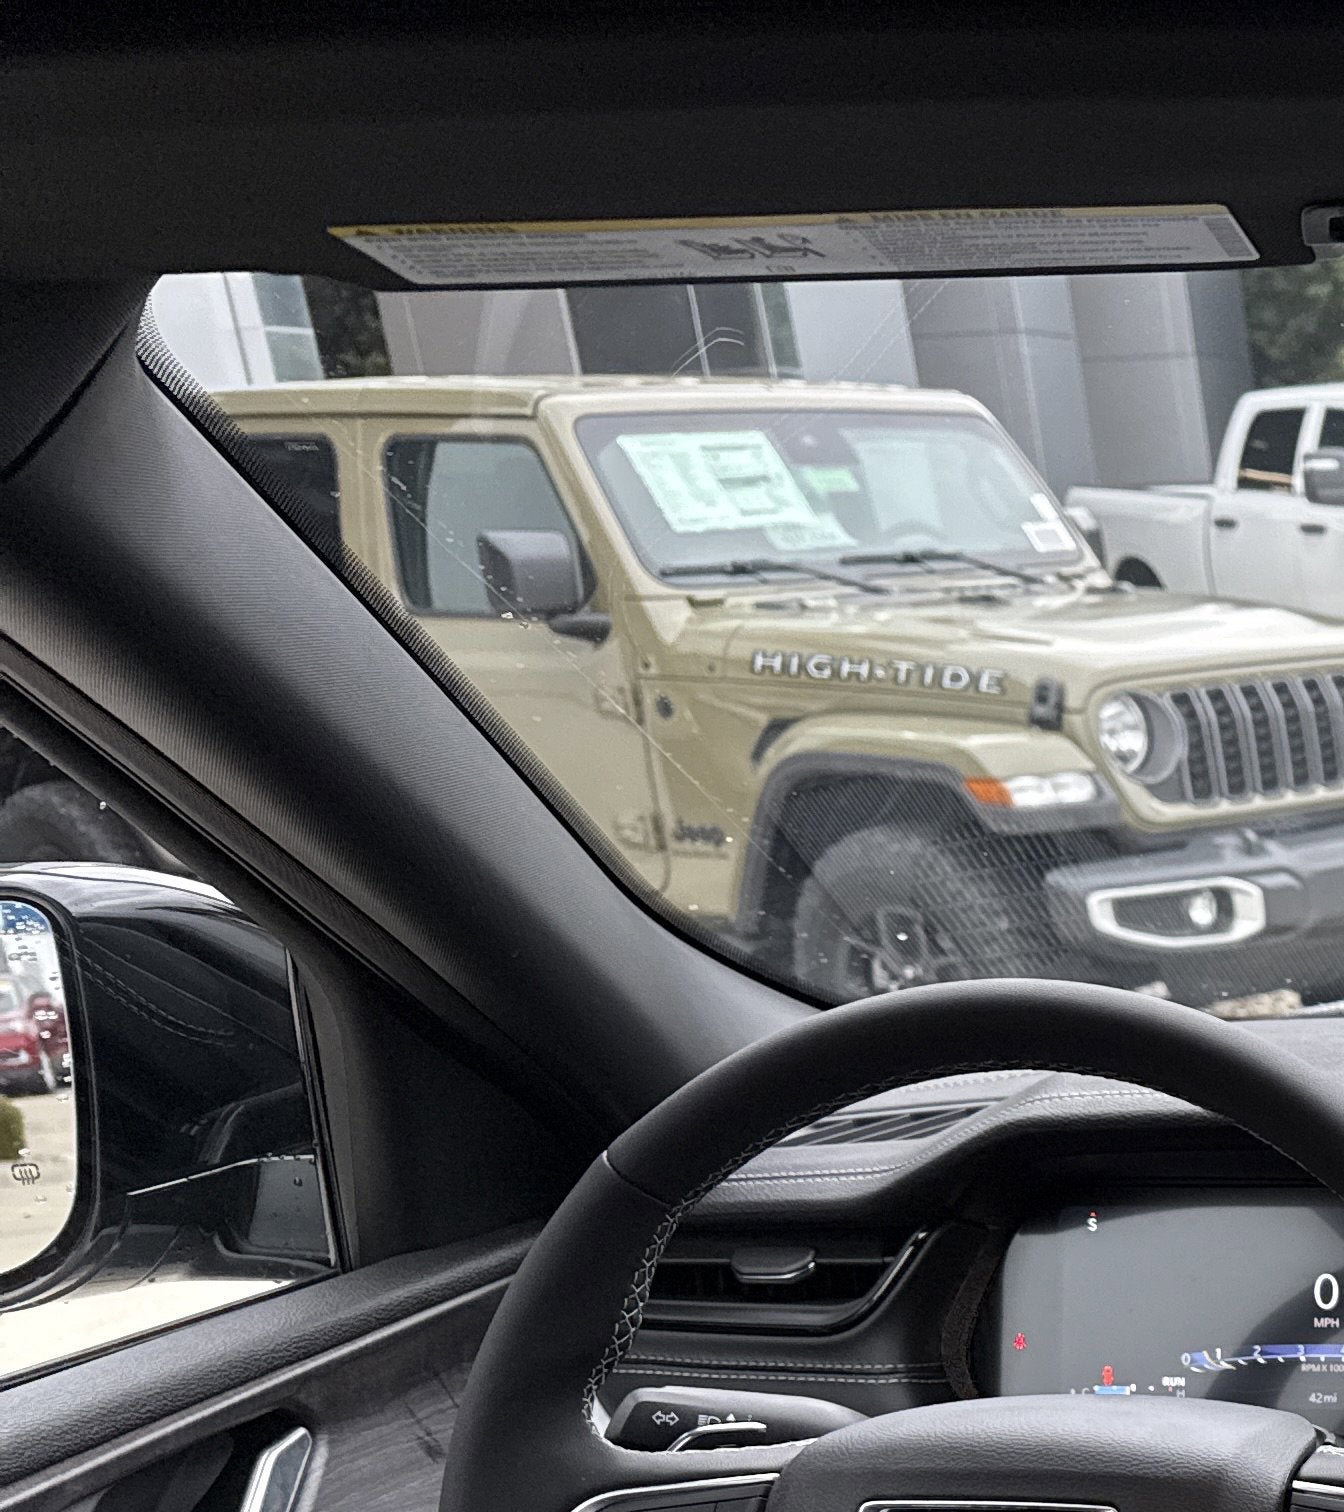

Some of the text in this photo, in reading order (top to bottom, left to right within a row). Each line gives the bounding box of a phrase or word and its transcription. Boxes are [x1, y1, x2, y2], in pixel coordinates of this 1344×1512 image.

[1087, 1217, 1098, 1232] S
[1313, 1273, 1340, 1310] 0
[1313, 1316, 1340, 1328] MPH
[1252, 1344, 1262, 1358] 2
[1297, 1344, 1305, 1356] 3
[1301, 1363, 1321, 1372] RPM
